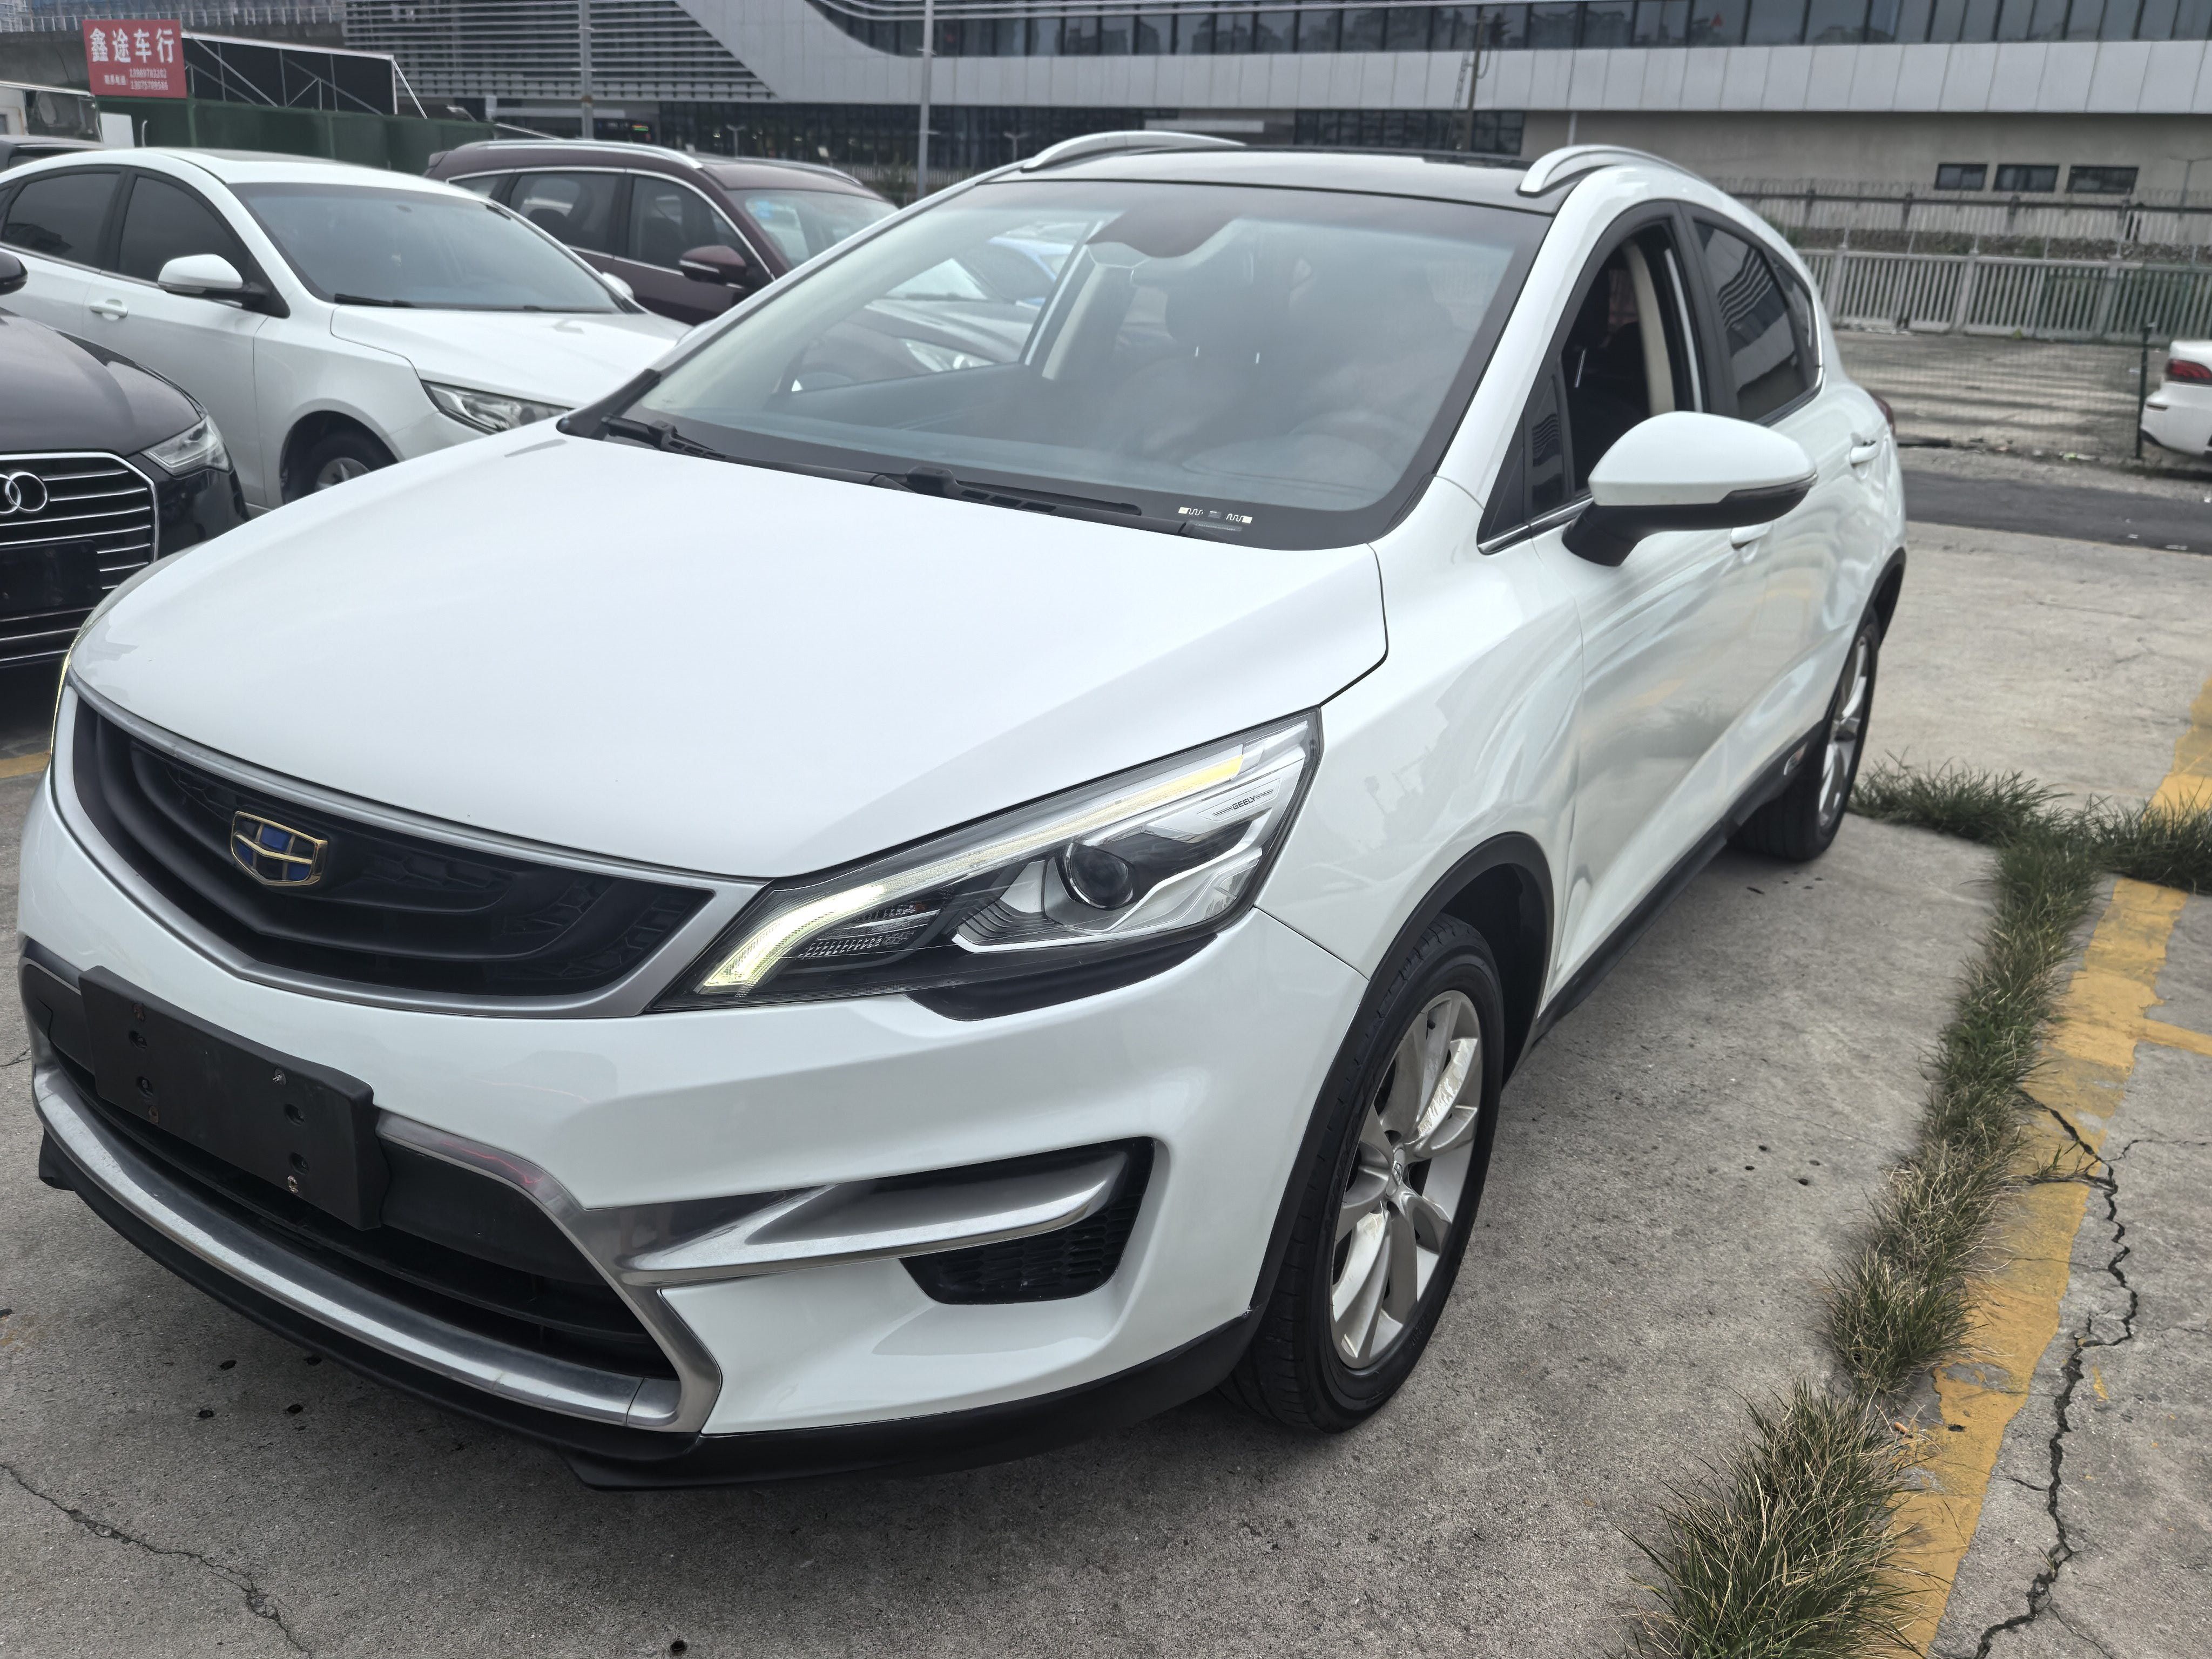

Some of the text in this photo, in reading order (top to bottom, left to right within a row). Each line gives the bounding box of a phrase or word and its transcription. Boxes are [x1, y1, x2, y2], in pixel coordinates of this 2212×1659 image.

[90, 28, 174, 63] 鑫途车行
[1232, 795, 1256, 810] GEELY
